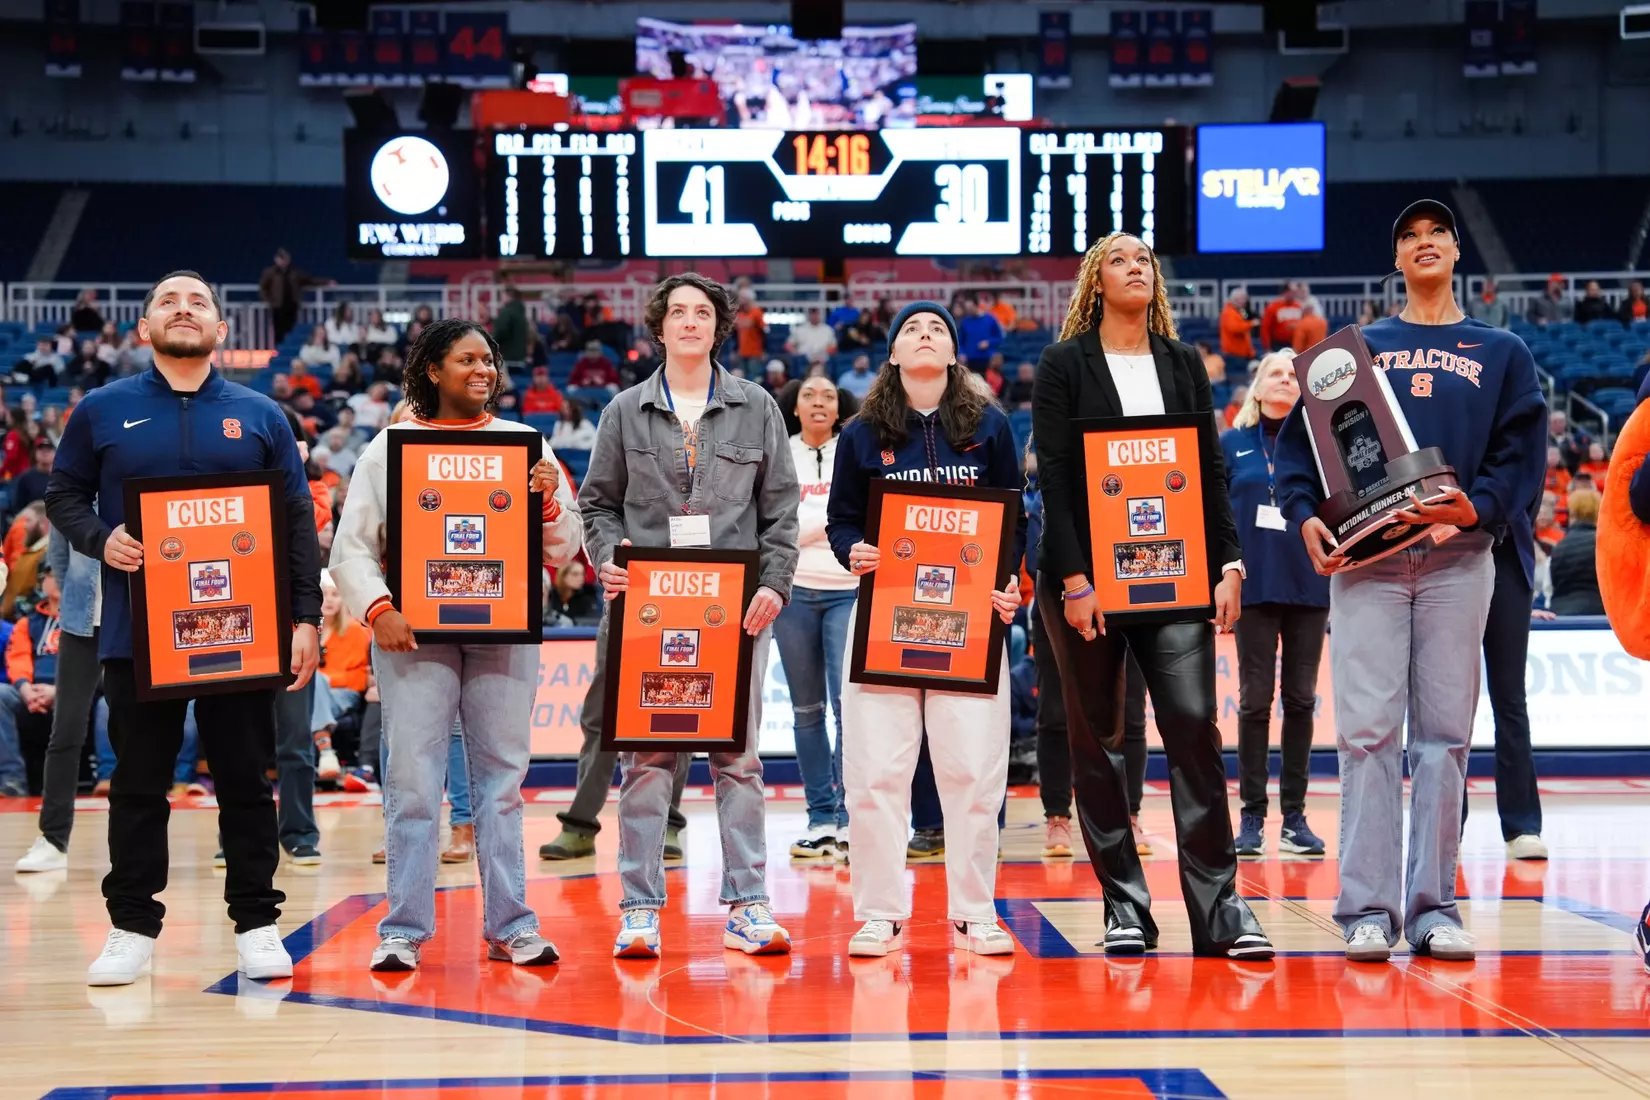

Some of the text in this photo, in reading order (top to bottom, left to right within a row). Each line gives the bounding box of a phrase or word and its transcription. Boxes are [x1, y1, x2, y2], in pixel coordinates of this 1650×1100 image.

[449, 26, 503, 60] 44
[793, 134, 870, 175] 14:16
[679, 165, 724, 224] 41
[935, 164, 988, 223] 30
[400, 223, 465, 244] WEBB
[499, 234, 519, 256] 17
[544, 234, 556, 256] 7
[1313, 361, 1356, 396] NCAA
[1411, 373, 1433, 397] S
[222, 418, 242, 439] S
[1338, 412, 1365, 432] DIVISION
[1110, 439, 1170, 465] 'CUSE
[431, 455, 496, 480] 'CUSE
[885, 465, 979, 487] RACUSE
[170, 498, 237, 526] 'CUSE
[909, 506, 971, 534] 'CUSE
[1338, 485, 1416, 535] NATIONAL RUNNER-UP
[653, 571, 713, 597] 'CUSE
